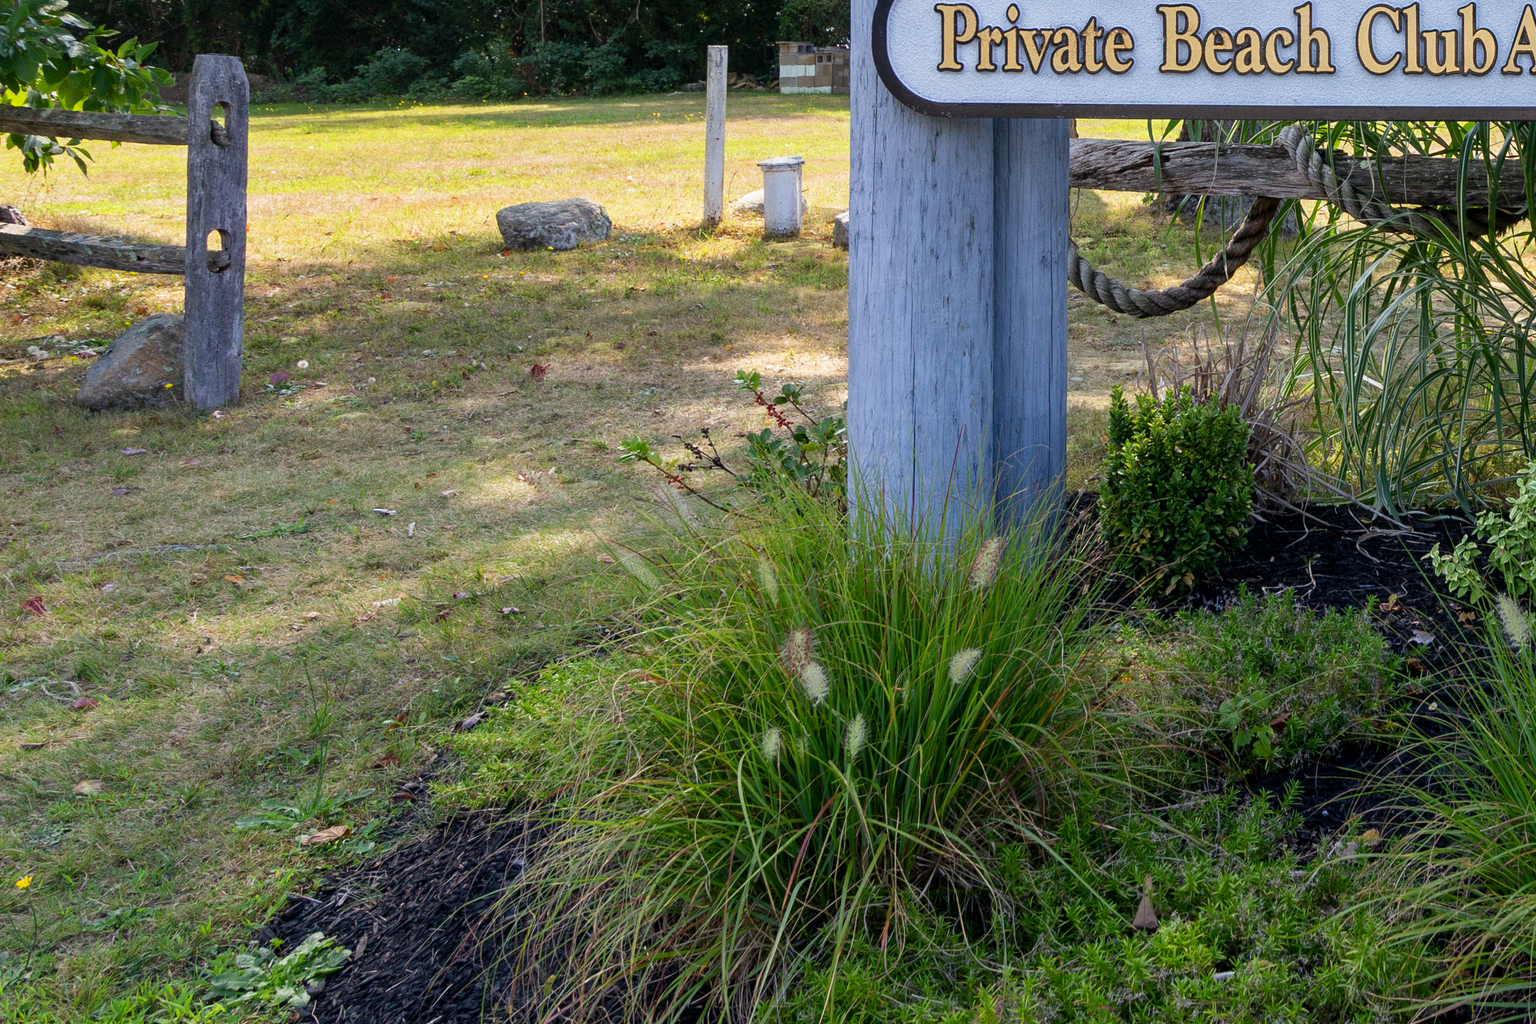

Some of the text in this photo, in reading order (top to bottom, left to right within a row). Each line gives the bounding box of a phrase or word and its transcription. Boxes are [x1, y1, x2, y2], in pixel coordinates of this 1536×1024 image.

[933, 1, 1134, 76] Private
[1155, 1, 1336, 75] Beach
[1355, 1, 1499, 76] Club
